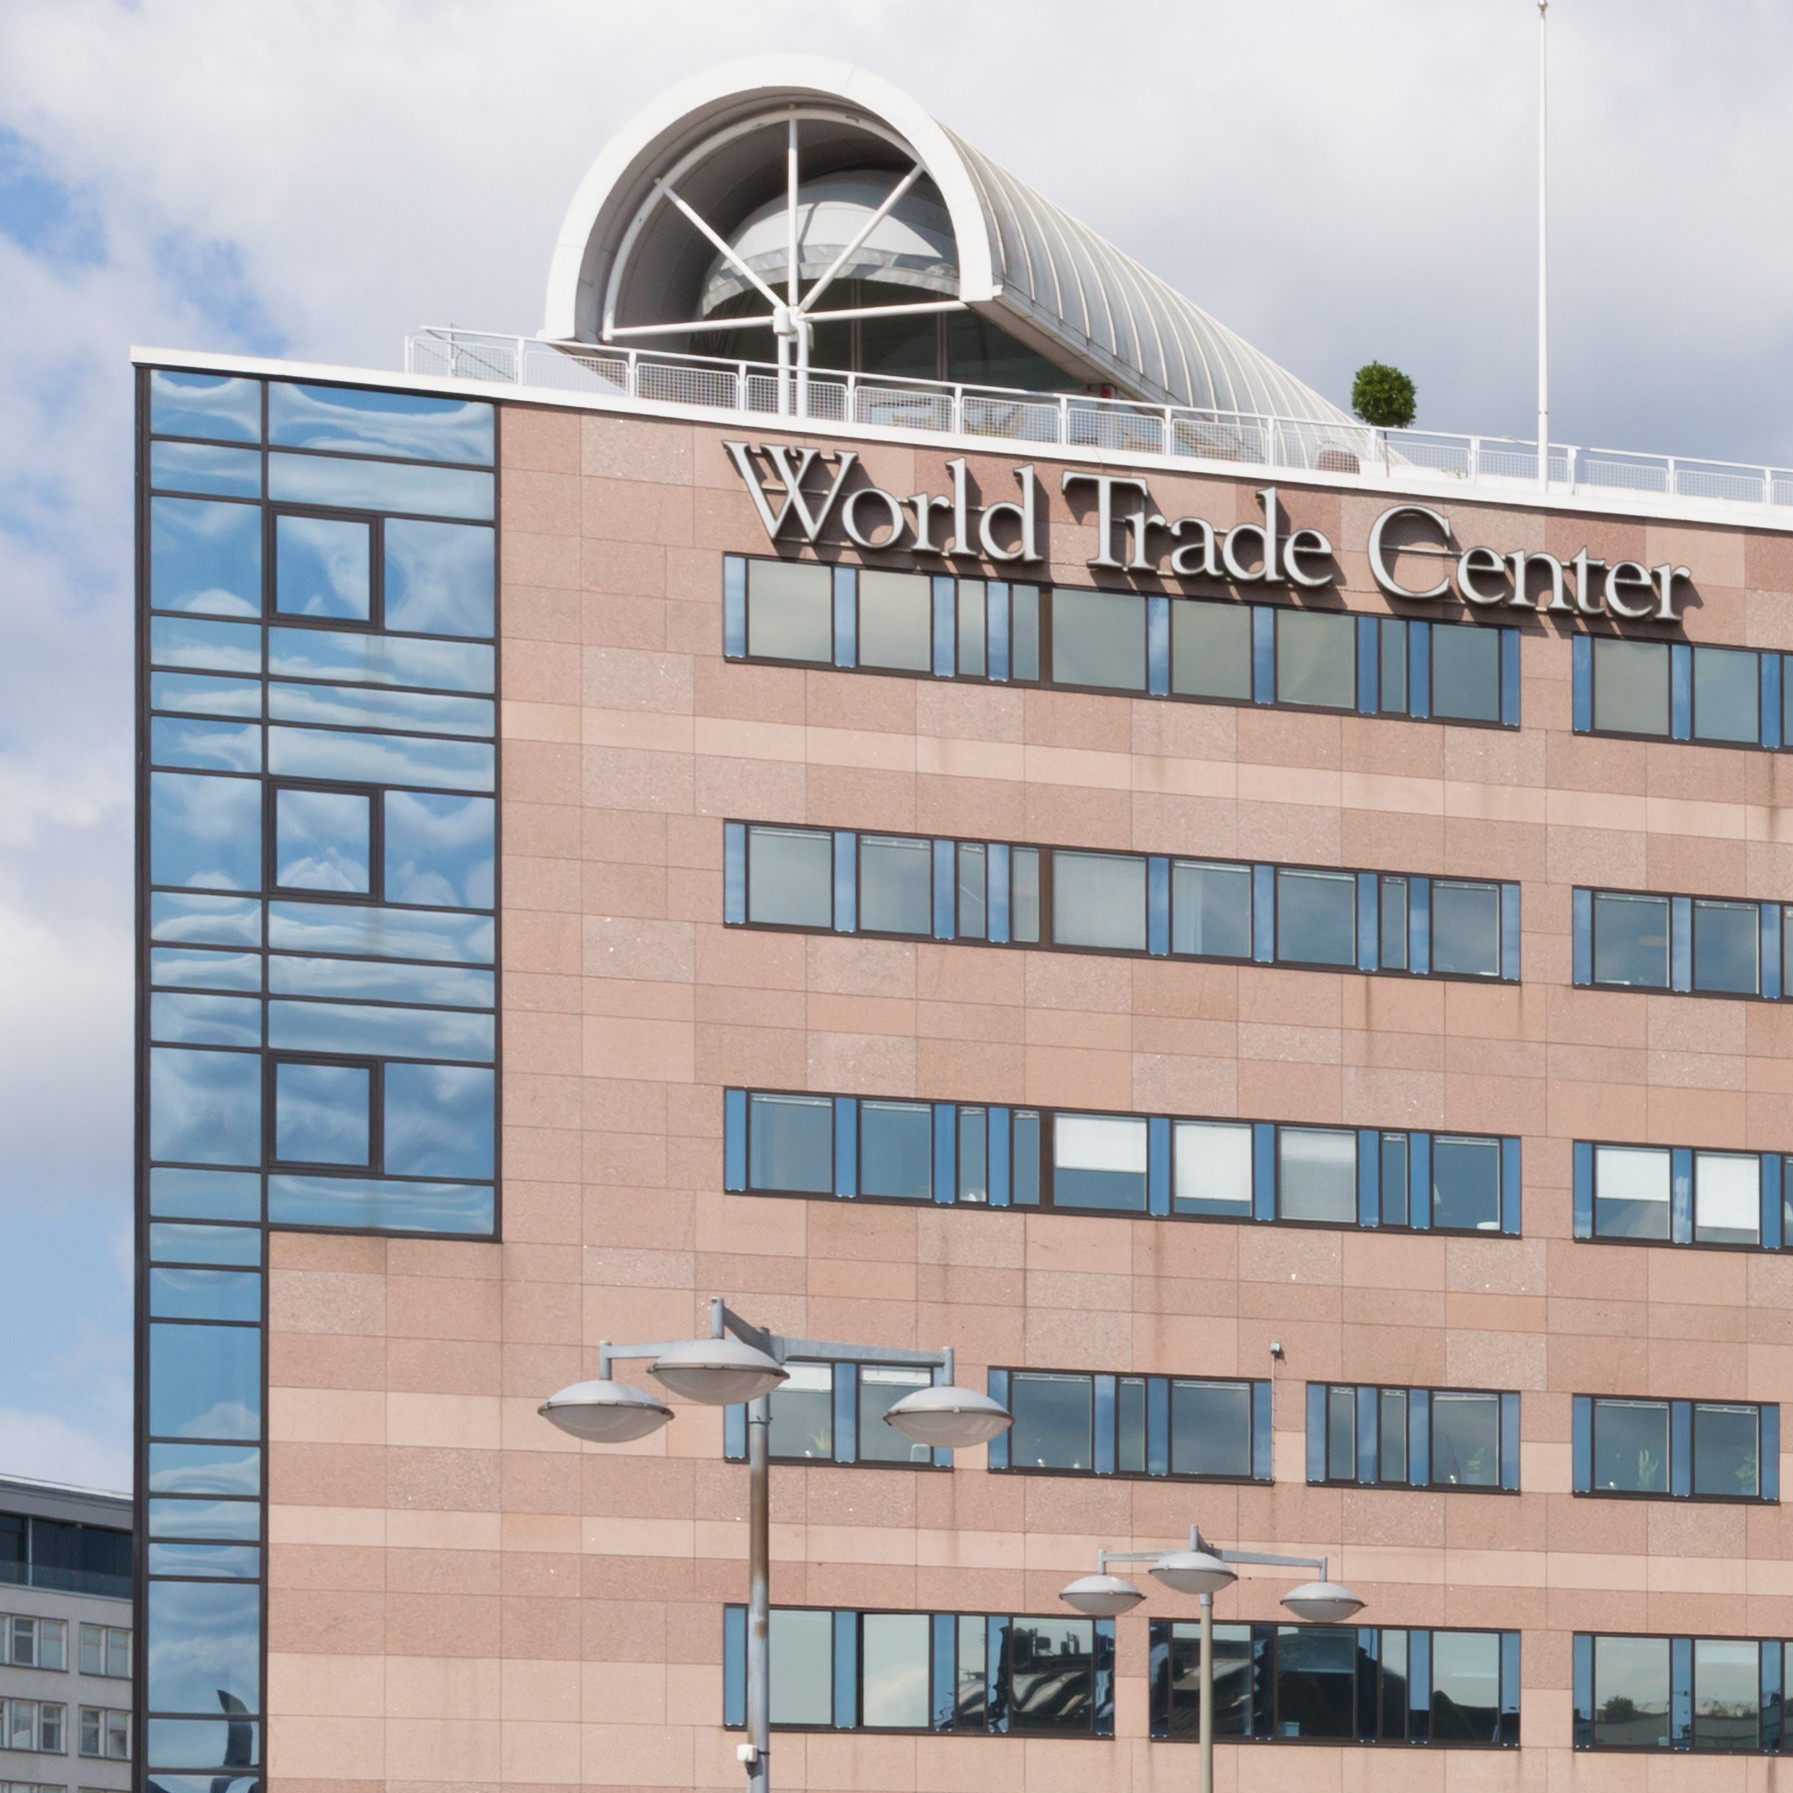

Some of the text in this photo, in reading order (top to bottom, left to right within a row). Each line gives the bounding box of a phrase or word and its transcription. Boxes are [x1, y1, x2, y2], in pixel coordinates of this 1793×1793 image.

[722, 438, 1692, 622] World Trade Center
